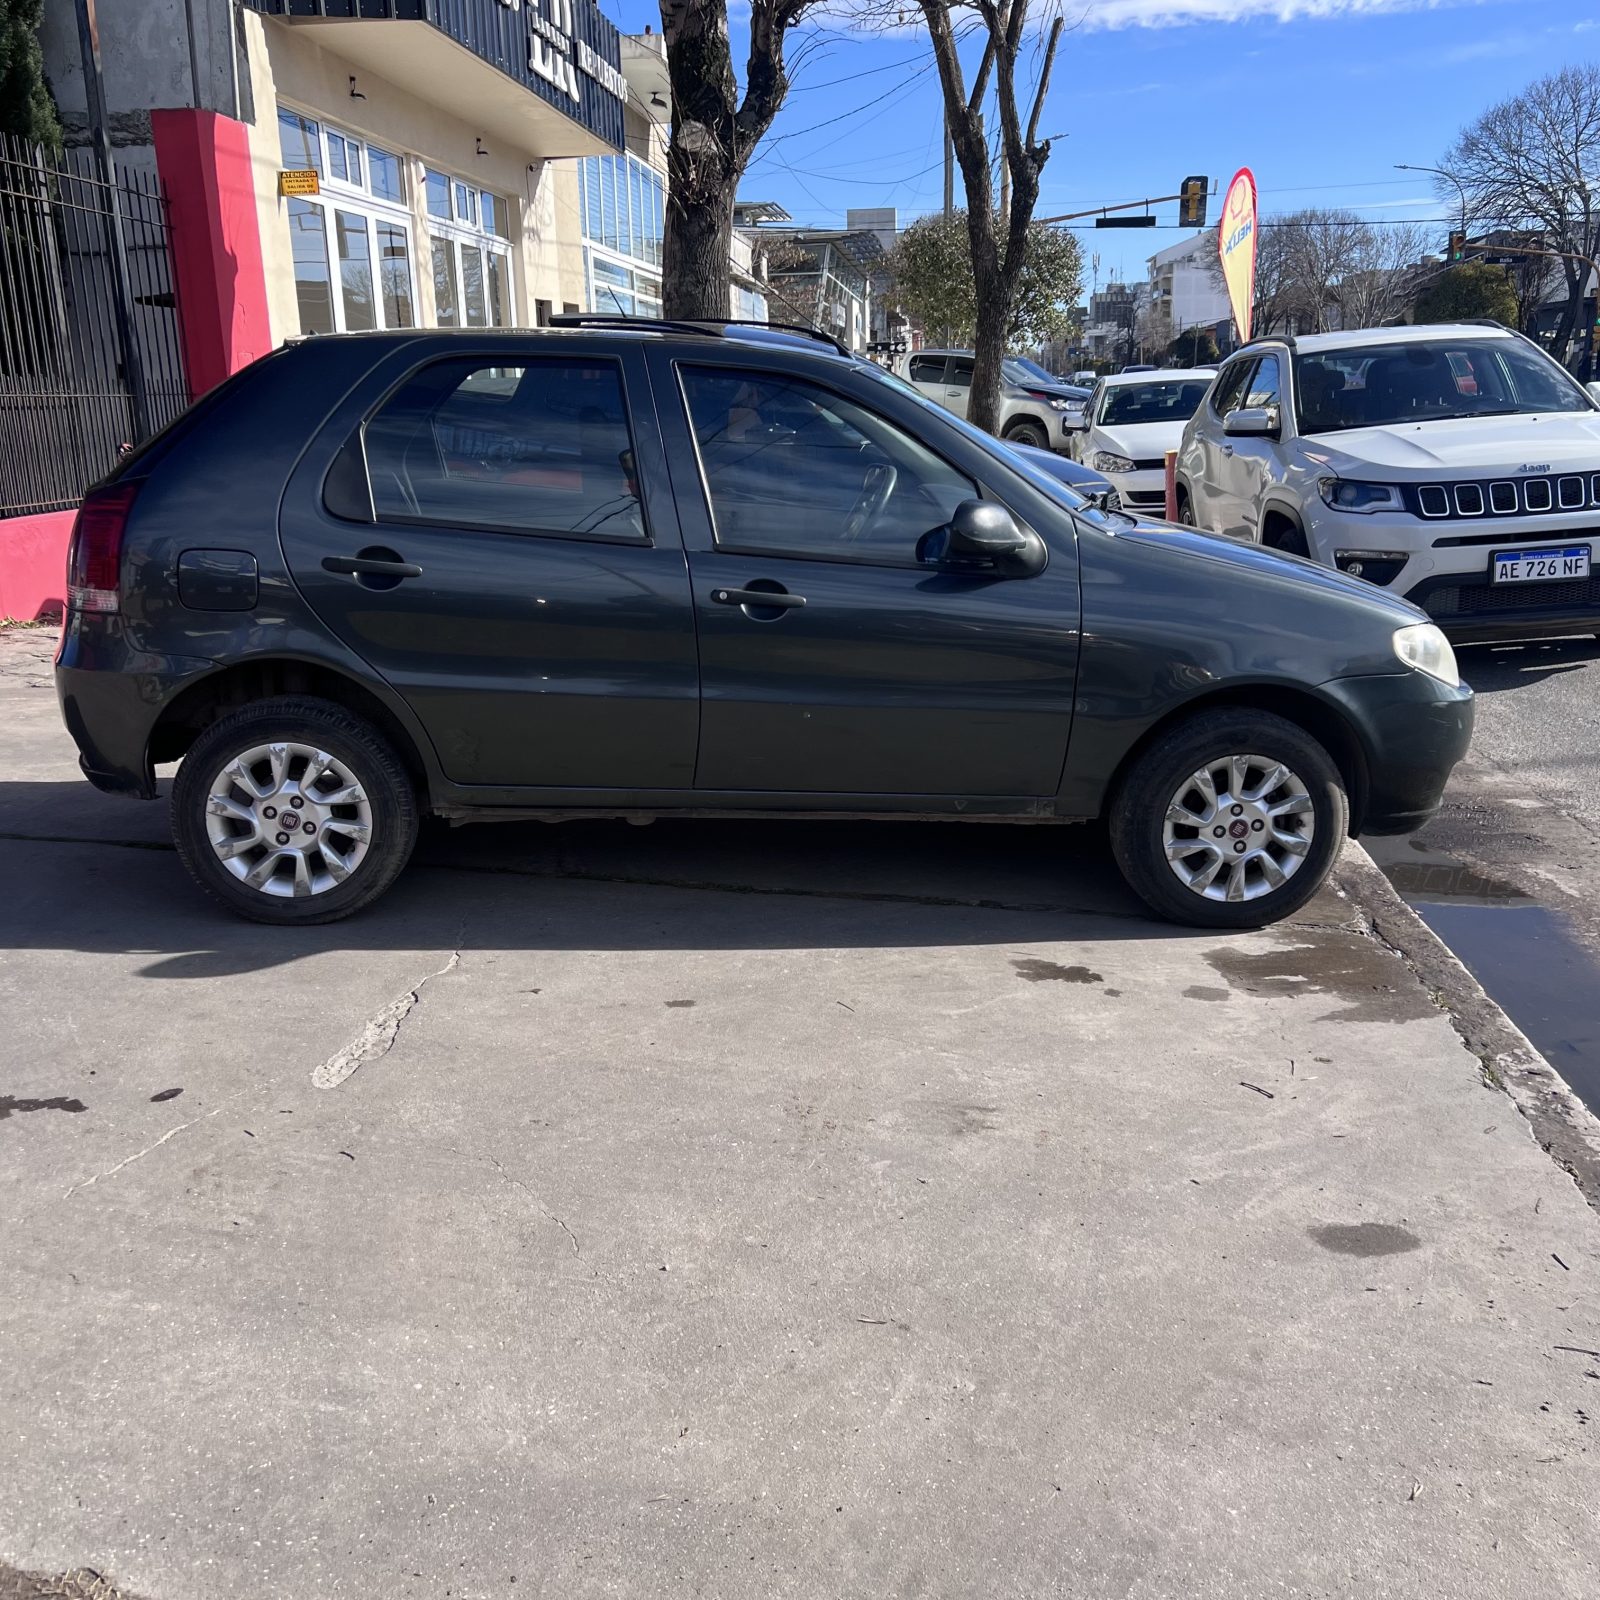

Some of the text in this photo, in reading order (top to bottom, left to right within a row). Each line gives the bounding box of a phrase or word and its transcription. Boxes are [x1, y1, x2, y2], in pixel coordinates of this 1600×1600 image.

[577, 39, 628, 103] REPUESTOS
[1519, 464, 1551, 473] Jeep
[1499, 558, 1584, 580] AE 726 NF
